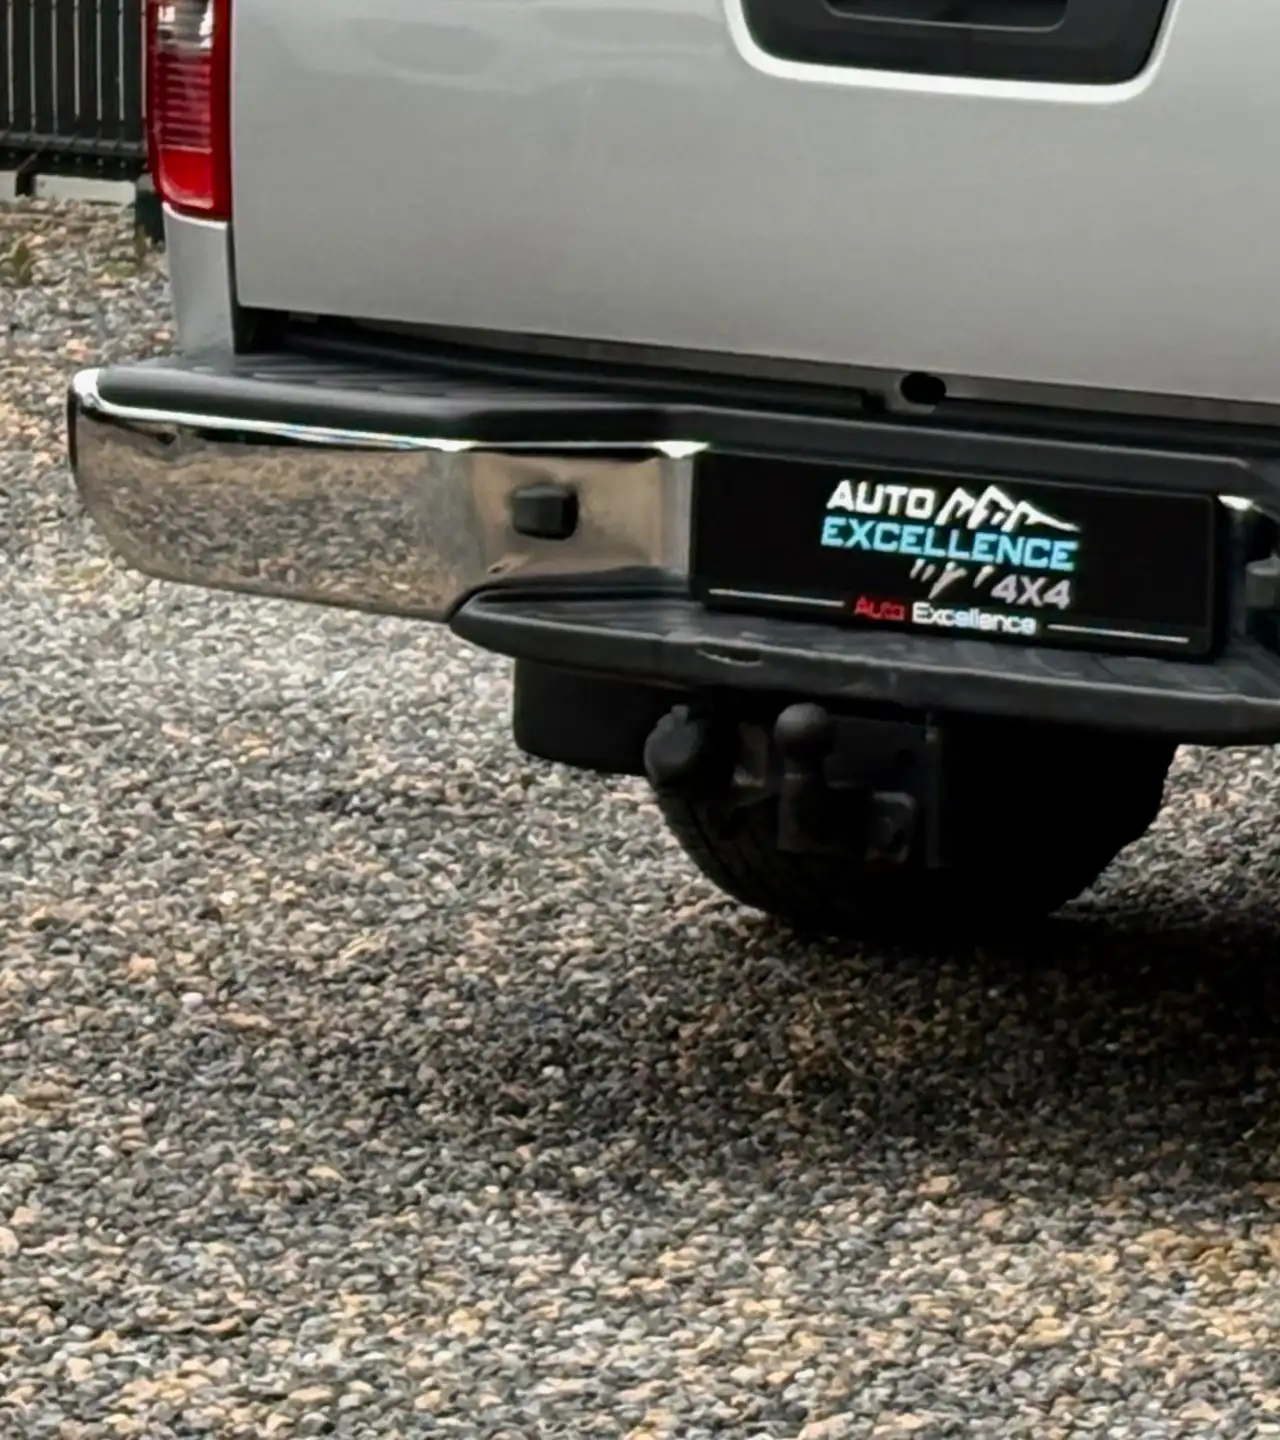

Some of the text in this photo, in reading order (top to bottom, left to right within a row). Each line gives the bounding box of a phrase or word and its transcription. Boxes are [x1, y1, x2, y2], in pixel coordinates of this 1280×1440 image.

[826, 479, 936, 519] AUTO
[820, 516, 1079, 572] EXCELLENCE
[990, 573, 1072, 610] 4X4
[911, 601, 1038, 636] Excellence
